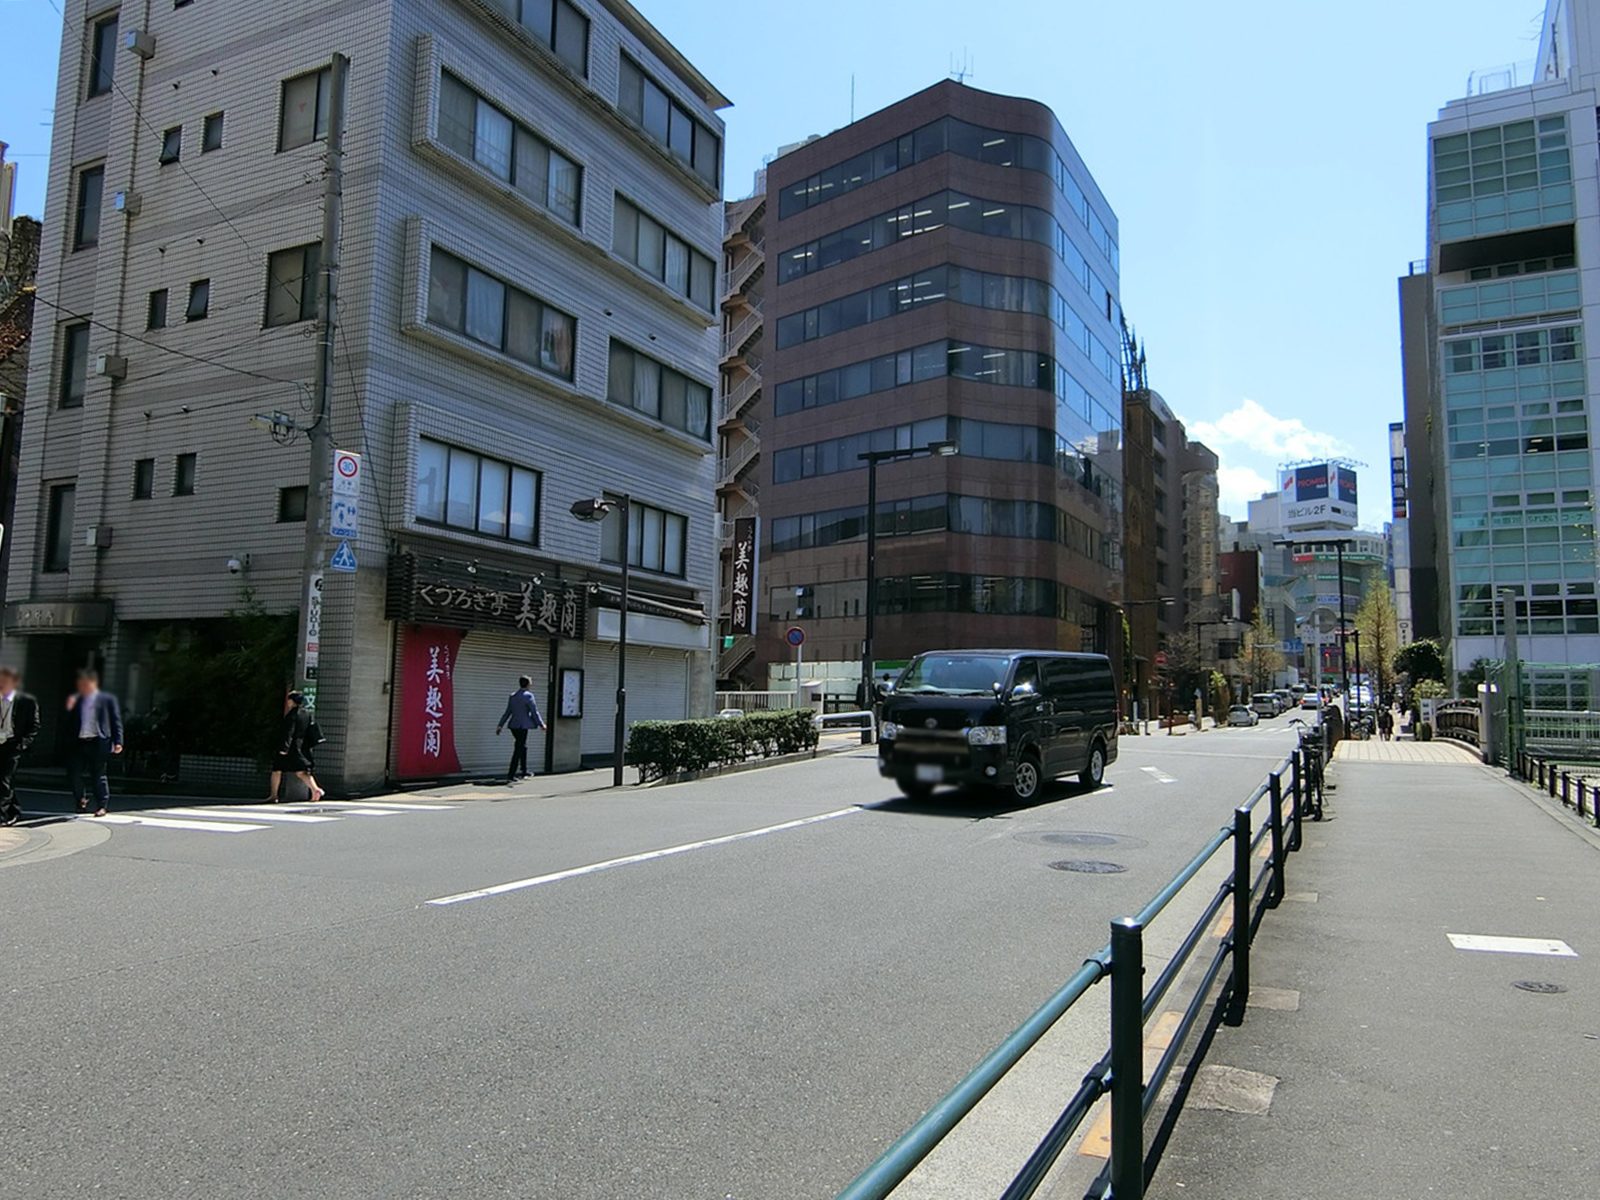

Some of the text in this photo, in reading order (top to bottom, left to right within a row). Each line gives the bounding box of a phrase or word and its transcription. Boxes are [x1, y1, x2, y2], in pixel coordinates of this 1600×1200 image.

[342, 460, 353, 473] 30
[1288, 504, 1327, 518] 当ビル2F
